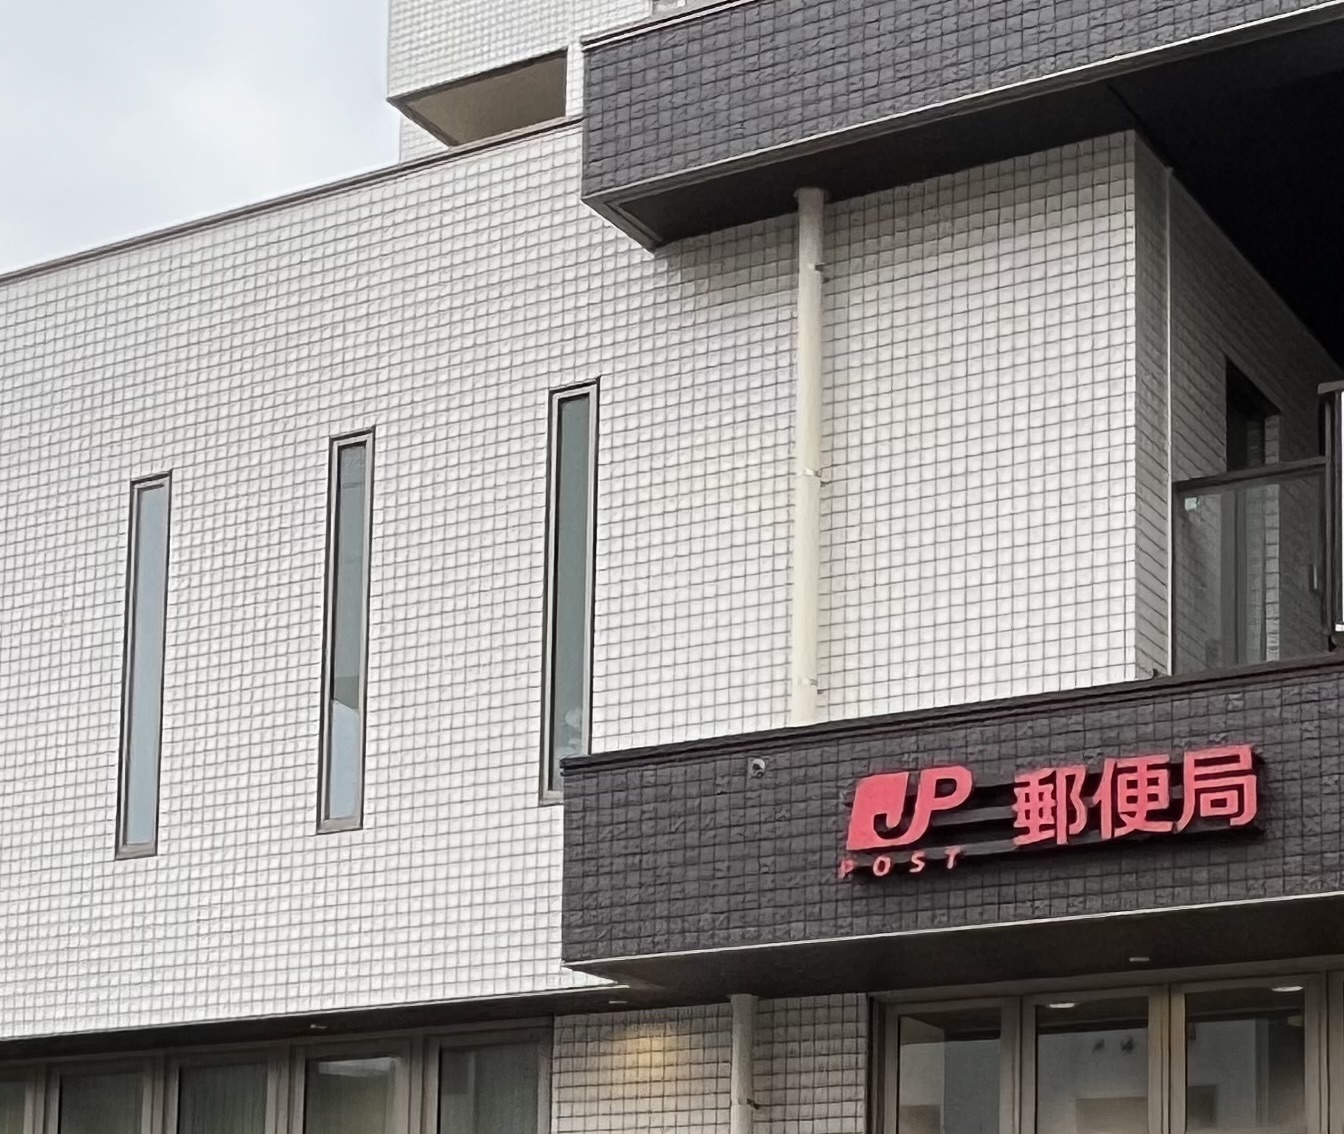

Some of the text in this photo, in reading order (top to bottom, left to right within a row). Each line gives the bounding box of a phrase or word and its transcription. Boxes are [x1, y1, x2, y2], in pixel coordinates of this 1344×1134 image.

[846, 743, 1257, 851] JP 郵便局
[837, 846, 962, 880] POST
